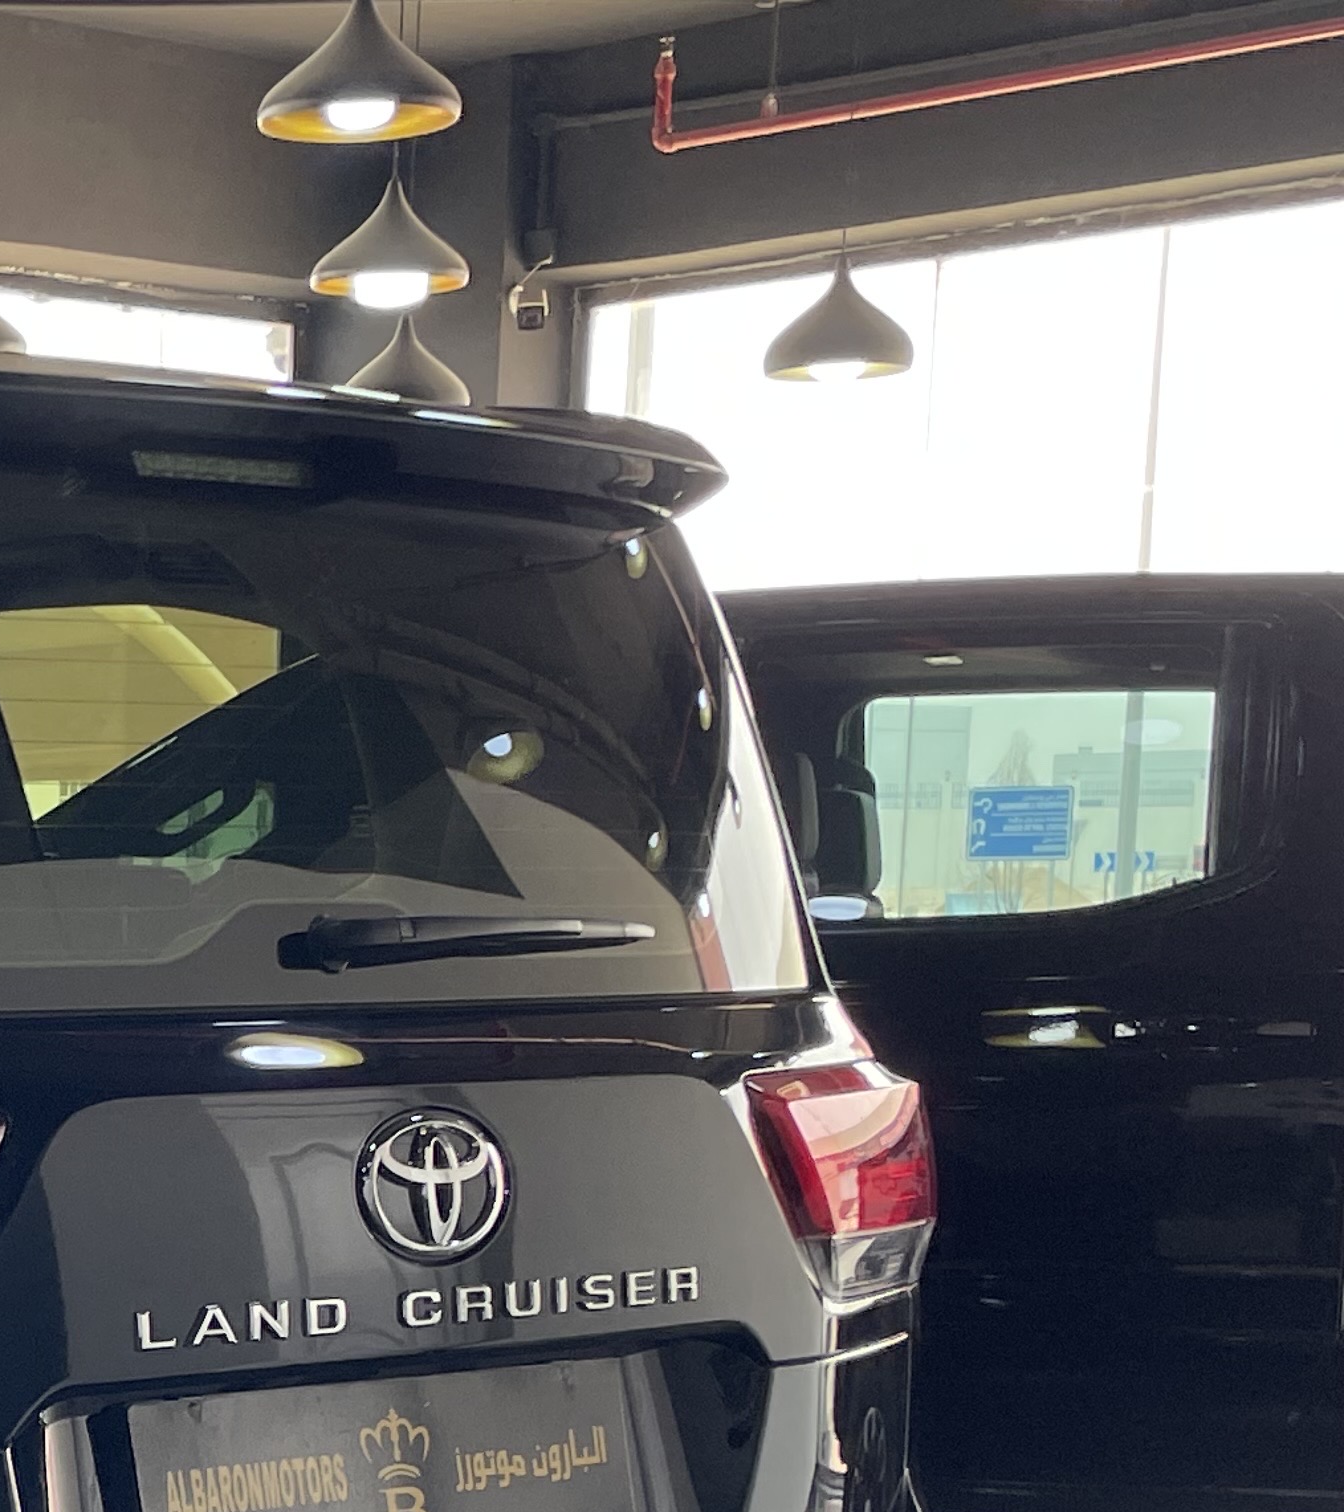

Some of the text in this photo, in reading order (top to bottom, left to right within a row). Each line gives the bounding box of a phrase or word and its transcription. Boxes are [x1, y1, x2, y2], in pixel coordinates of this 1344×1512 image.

[135, 1266, 699, 1350] LAND CRUISER
[454, 1424, 608, 1493] البارون موتورز
